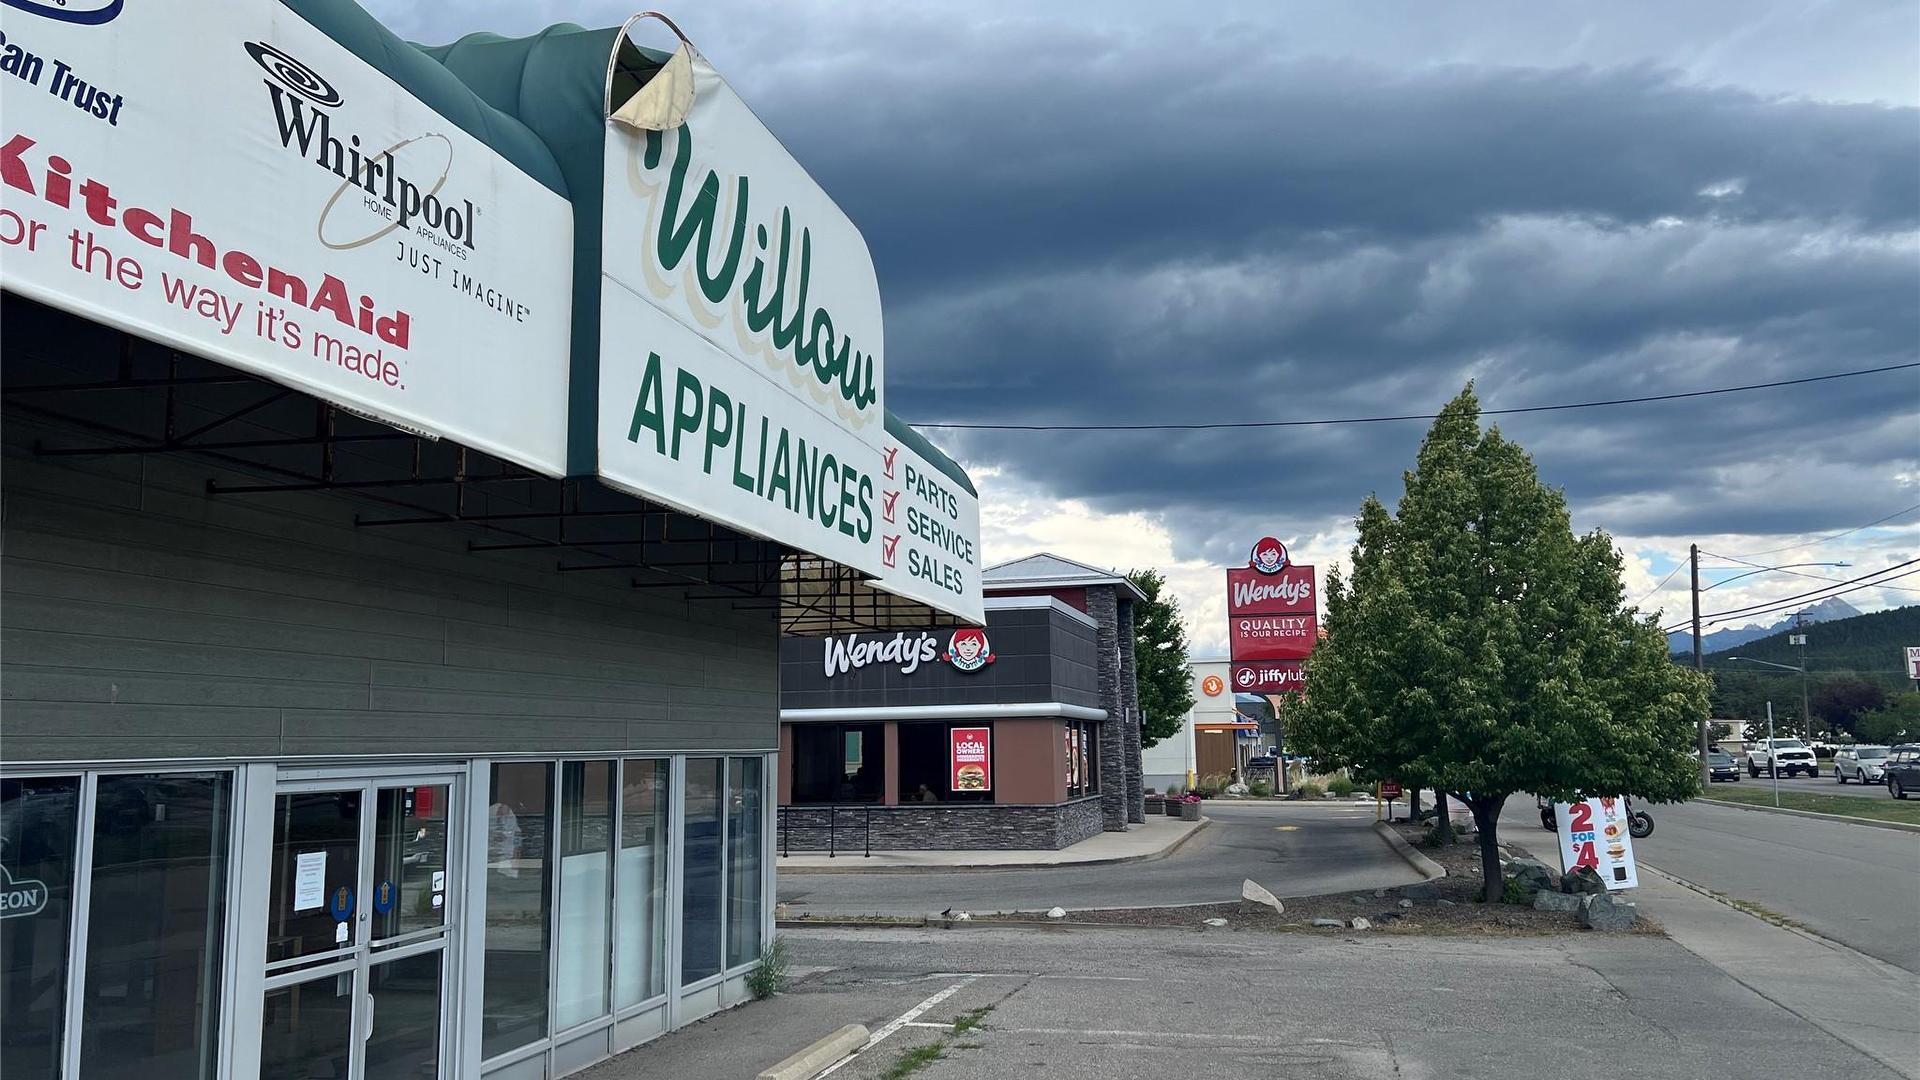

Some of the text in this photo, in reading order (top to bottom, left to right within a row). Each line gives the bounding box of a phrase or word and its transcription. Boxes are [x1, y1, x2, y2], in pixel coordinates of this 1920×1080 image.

[49, 59, 124, 127] Trust
[364, 196, 392, 221] HOME
[397, 241, 442, 279] JUST
[416, 225, 467, 261] APPLIANCES
[643, 120, 876, 411] Willow
[68, 228, 143, 290] the
[161, 272, 243, 335] way
[257, 301, 301, 349] it's
[313, 331, 405, 390] made.
[627, 351, 874, 544] APPLIANCES
[905, 464, 958, 521] PARTS
[907, 506, 974, 566] SERVICE
[908, 548, 963, 595] SALES
[1233, 574, 1311, 608] Wendy's
[1240, 618, 1306, 631] QUALITY
[1251, 630, 1271, 638] OUR
[824, 631, 938, 678] Wendy's
[956, 741, 985, 749] LOCAL
[1568, 803, 1595, 832] 2
[1571, 832, 1596, 842] FOR
